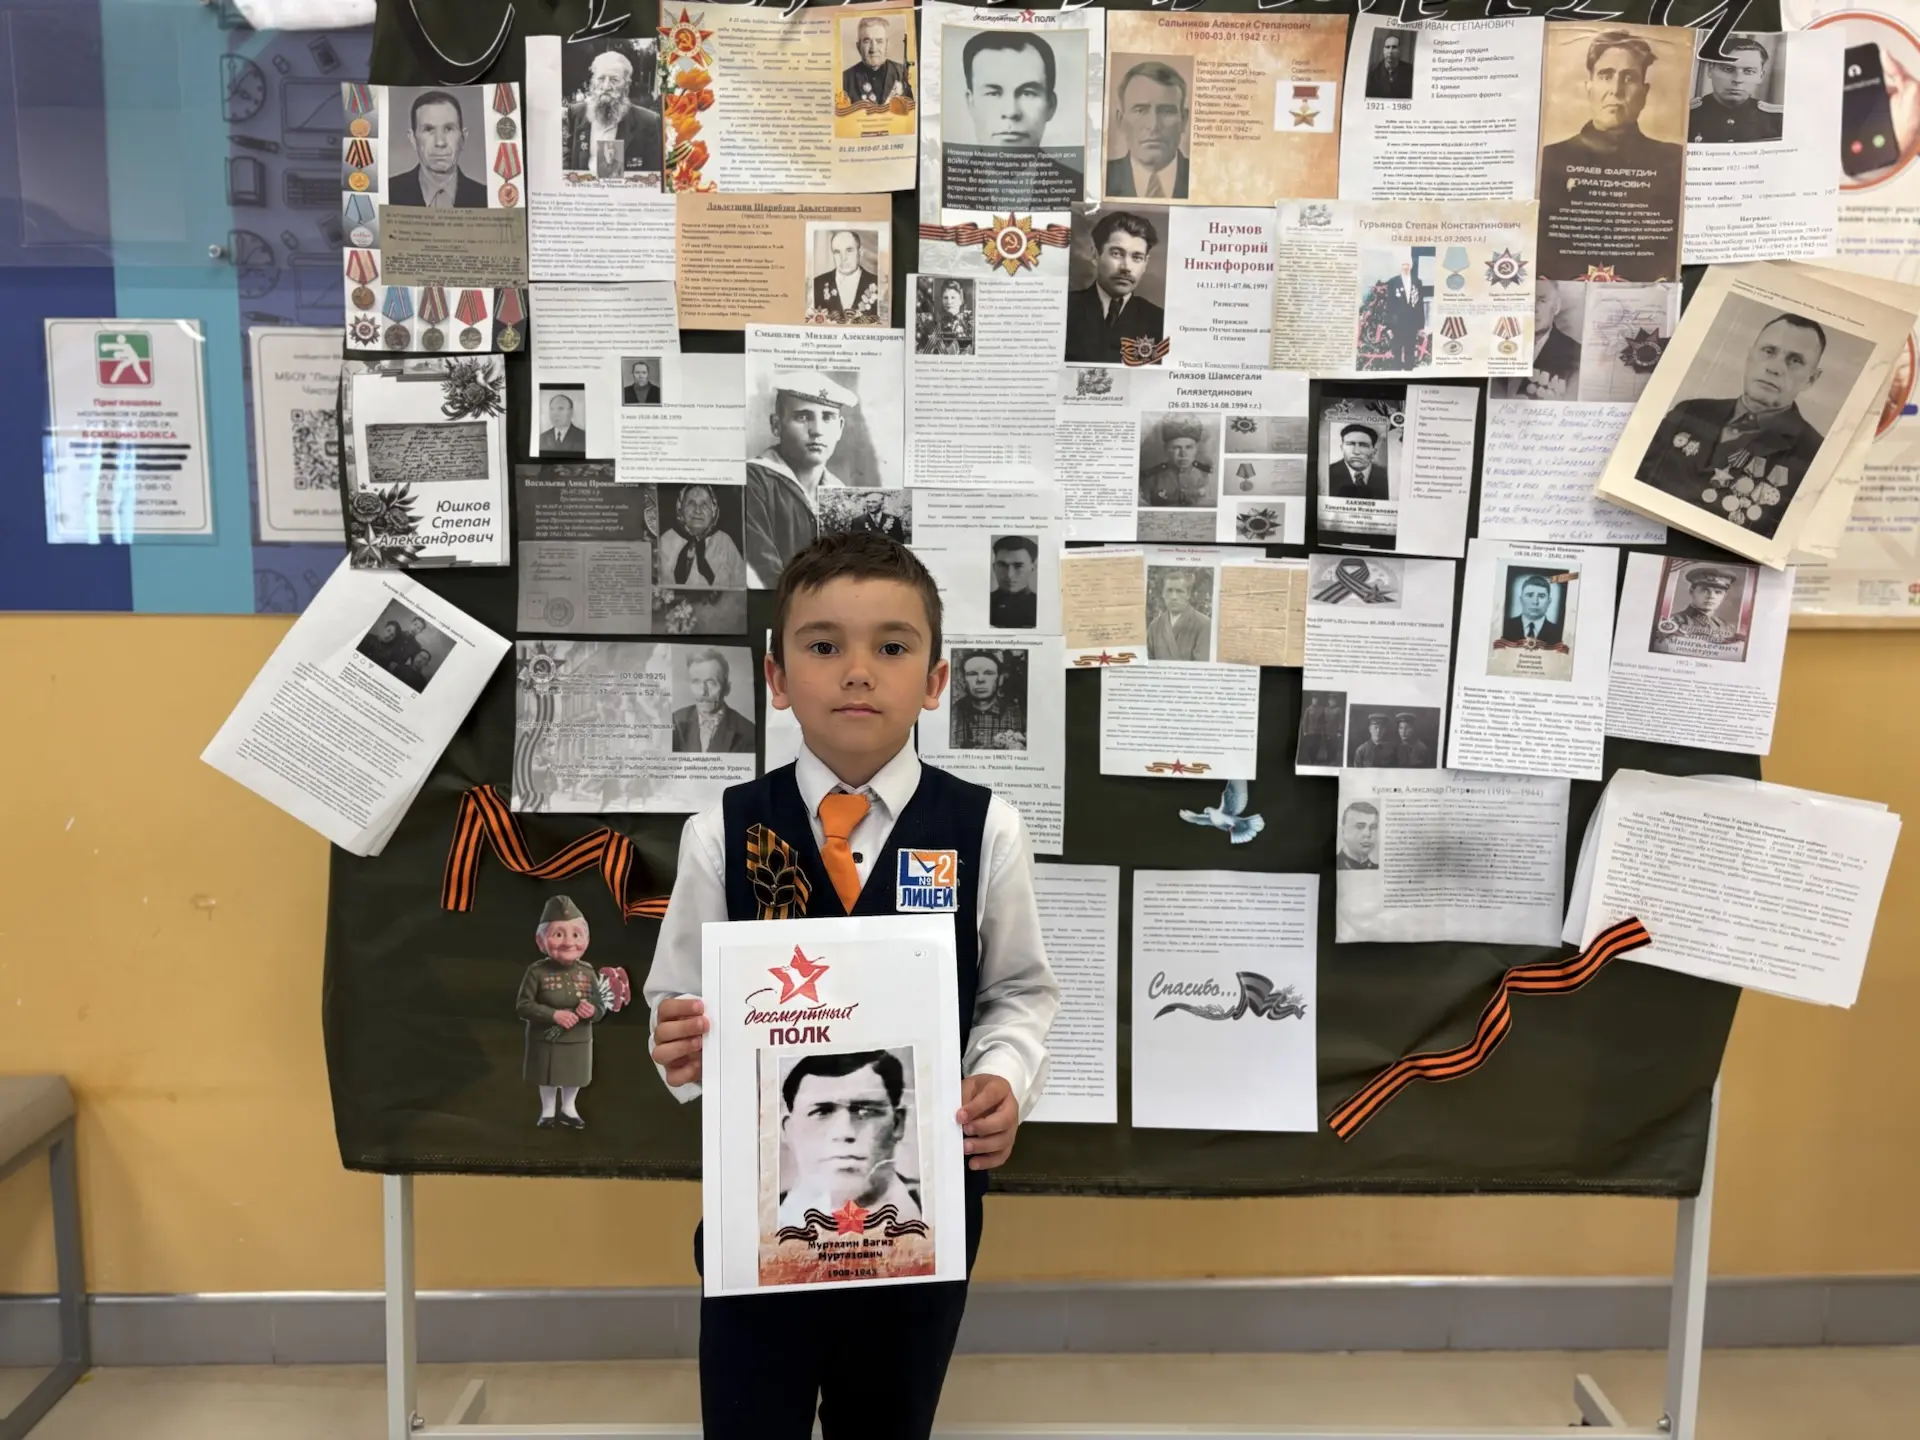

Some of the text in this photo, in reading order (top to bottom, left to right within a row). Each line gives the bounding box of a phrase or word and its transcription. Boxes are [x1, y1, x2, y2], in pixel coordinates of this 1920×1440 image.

[1158, 18, 1311, 30] Сальников Алексей Степанович
[1425, 19, 1449, 31] ИВАН
[1451, 19, 1515, 31] СТЕПАНОВИЧ
[1477, 55, 1515, 64] армейского
[1366, 102, 1412, 111] 1921 1980
[974, 150, 998, 158] Михаил
[1209, 221, 1263, 237] Наумов
[1359, 220, 1521, 230] Гурьянов Степан Константинович
[1200, 239, 1268, 255] Григорий
[1184, 257, 1274, 274] Никифорови
[804, 332, 837, 340] Михаил
[1169, 371, 1262, 380] Гилязов Шамсегали
[1177, 388, 1252, 397] Гилязетдинович
[436, 500, 490, 513] Юшков
[432, 516, 491, 529] Степан
[379, 531, 494, 546] Александрович
[918, 854, 951, 886] № 2
[900, 887, 953, 909] ЛИЦЕЙ
[1148, 971, 1237, 1000] Спасибо...
[744, 987, 859, 1027] бессмертный
[769, 1026, 831, 1045] ПОЛК
[808, 1238, 893, 1251] Муртазин Вагиз
[818, 1251, 883, 1262] Муртазович
